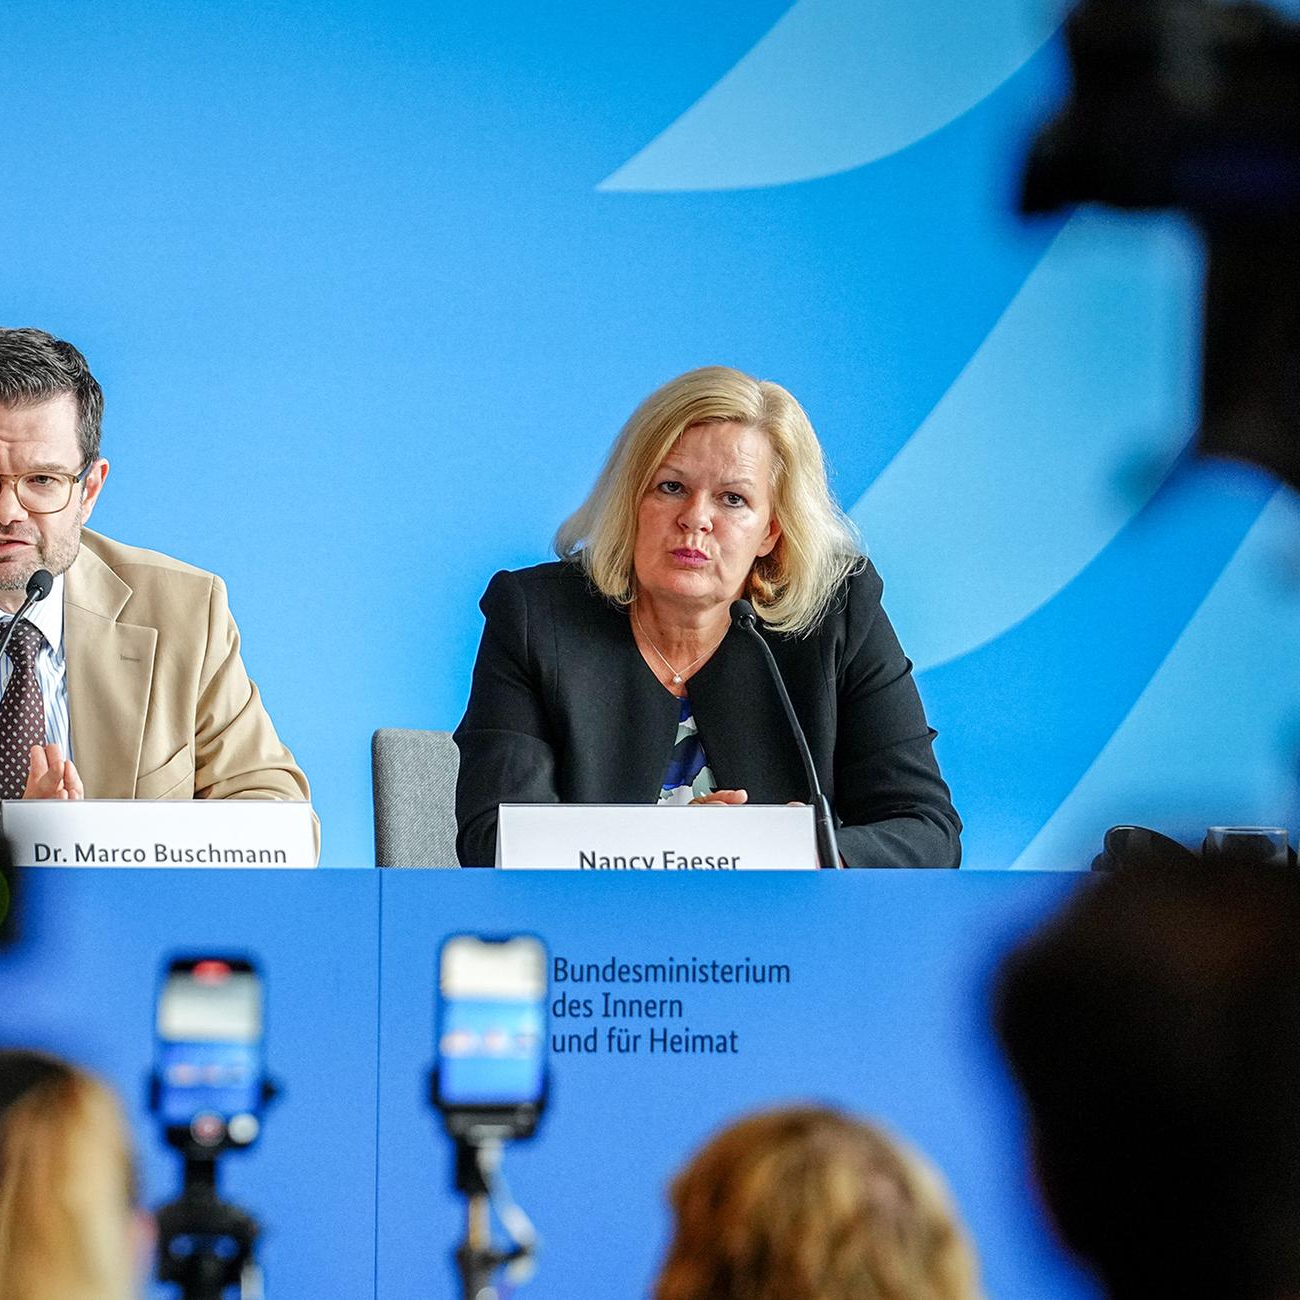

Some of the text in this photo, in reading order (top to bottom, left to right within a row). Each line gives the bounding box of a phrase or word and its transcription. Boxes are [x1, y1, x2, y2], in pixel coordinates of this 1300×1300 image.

[34, 843, 287, 864] Dr. Marco Buschmann
[662, 850, 741, 870] Faeser
[554, 956, 790, 983] Bundesministerium
[552, 991, 683, 1018] des Innern
[552, 1026, 738, 1053] und für Heimat
